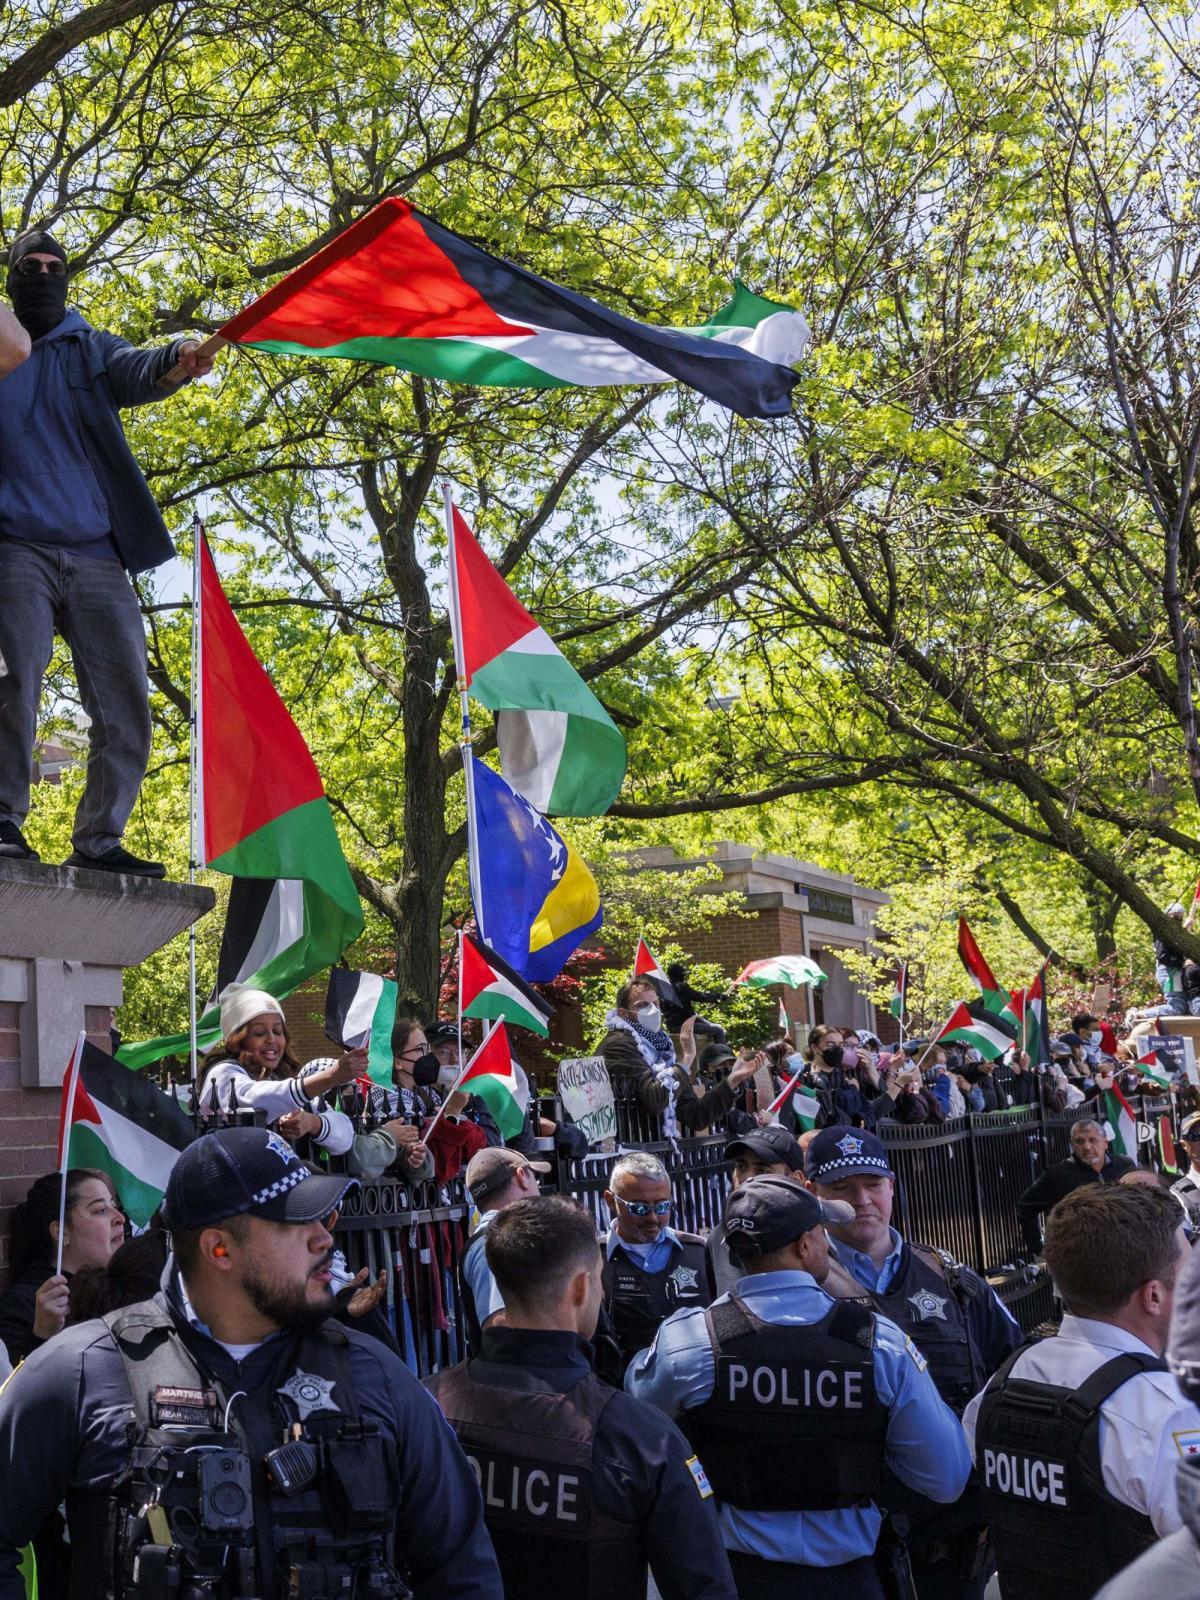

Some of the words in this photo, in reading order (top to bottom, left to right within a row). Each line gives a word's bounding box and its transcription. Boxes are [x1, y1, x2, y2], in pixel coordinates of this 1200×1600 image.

[729, 1364, 862, 1409] POLICE
[466, 1455, 579, 1521] LICE
[984, 1448, 1067, 1506] POLICE
